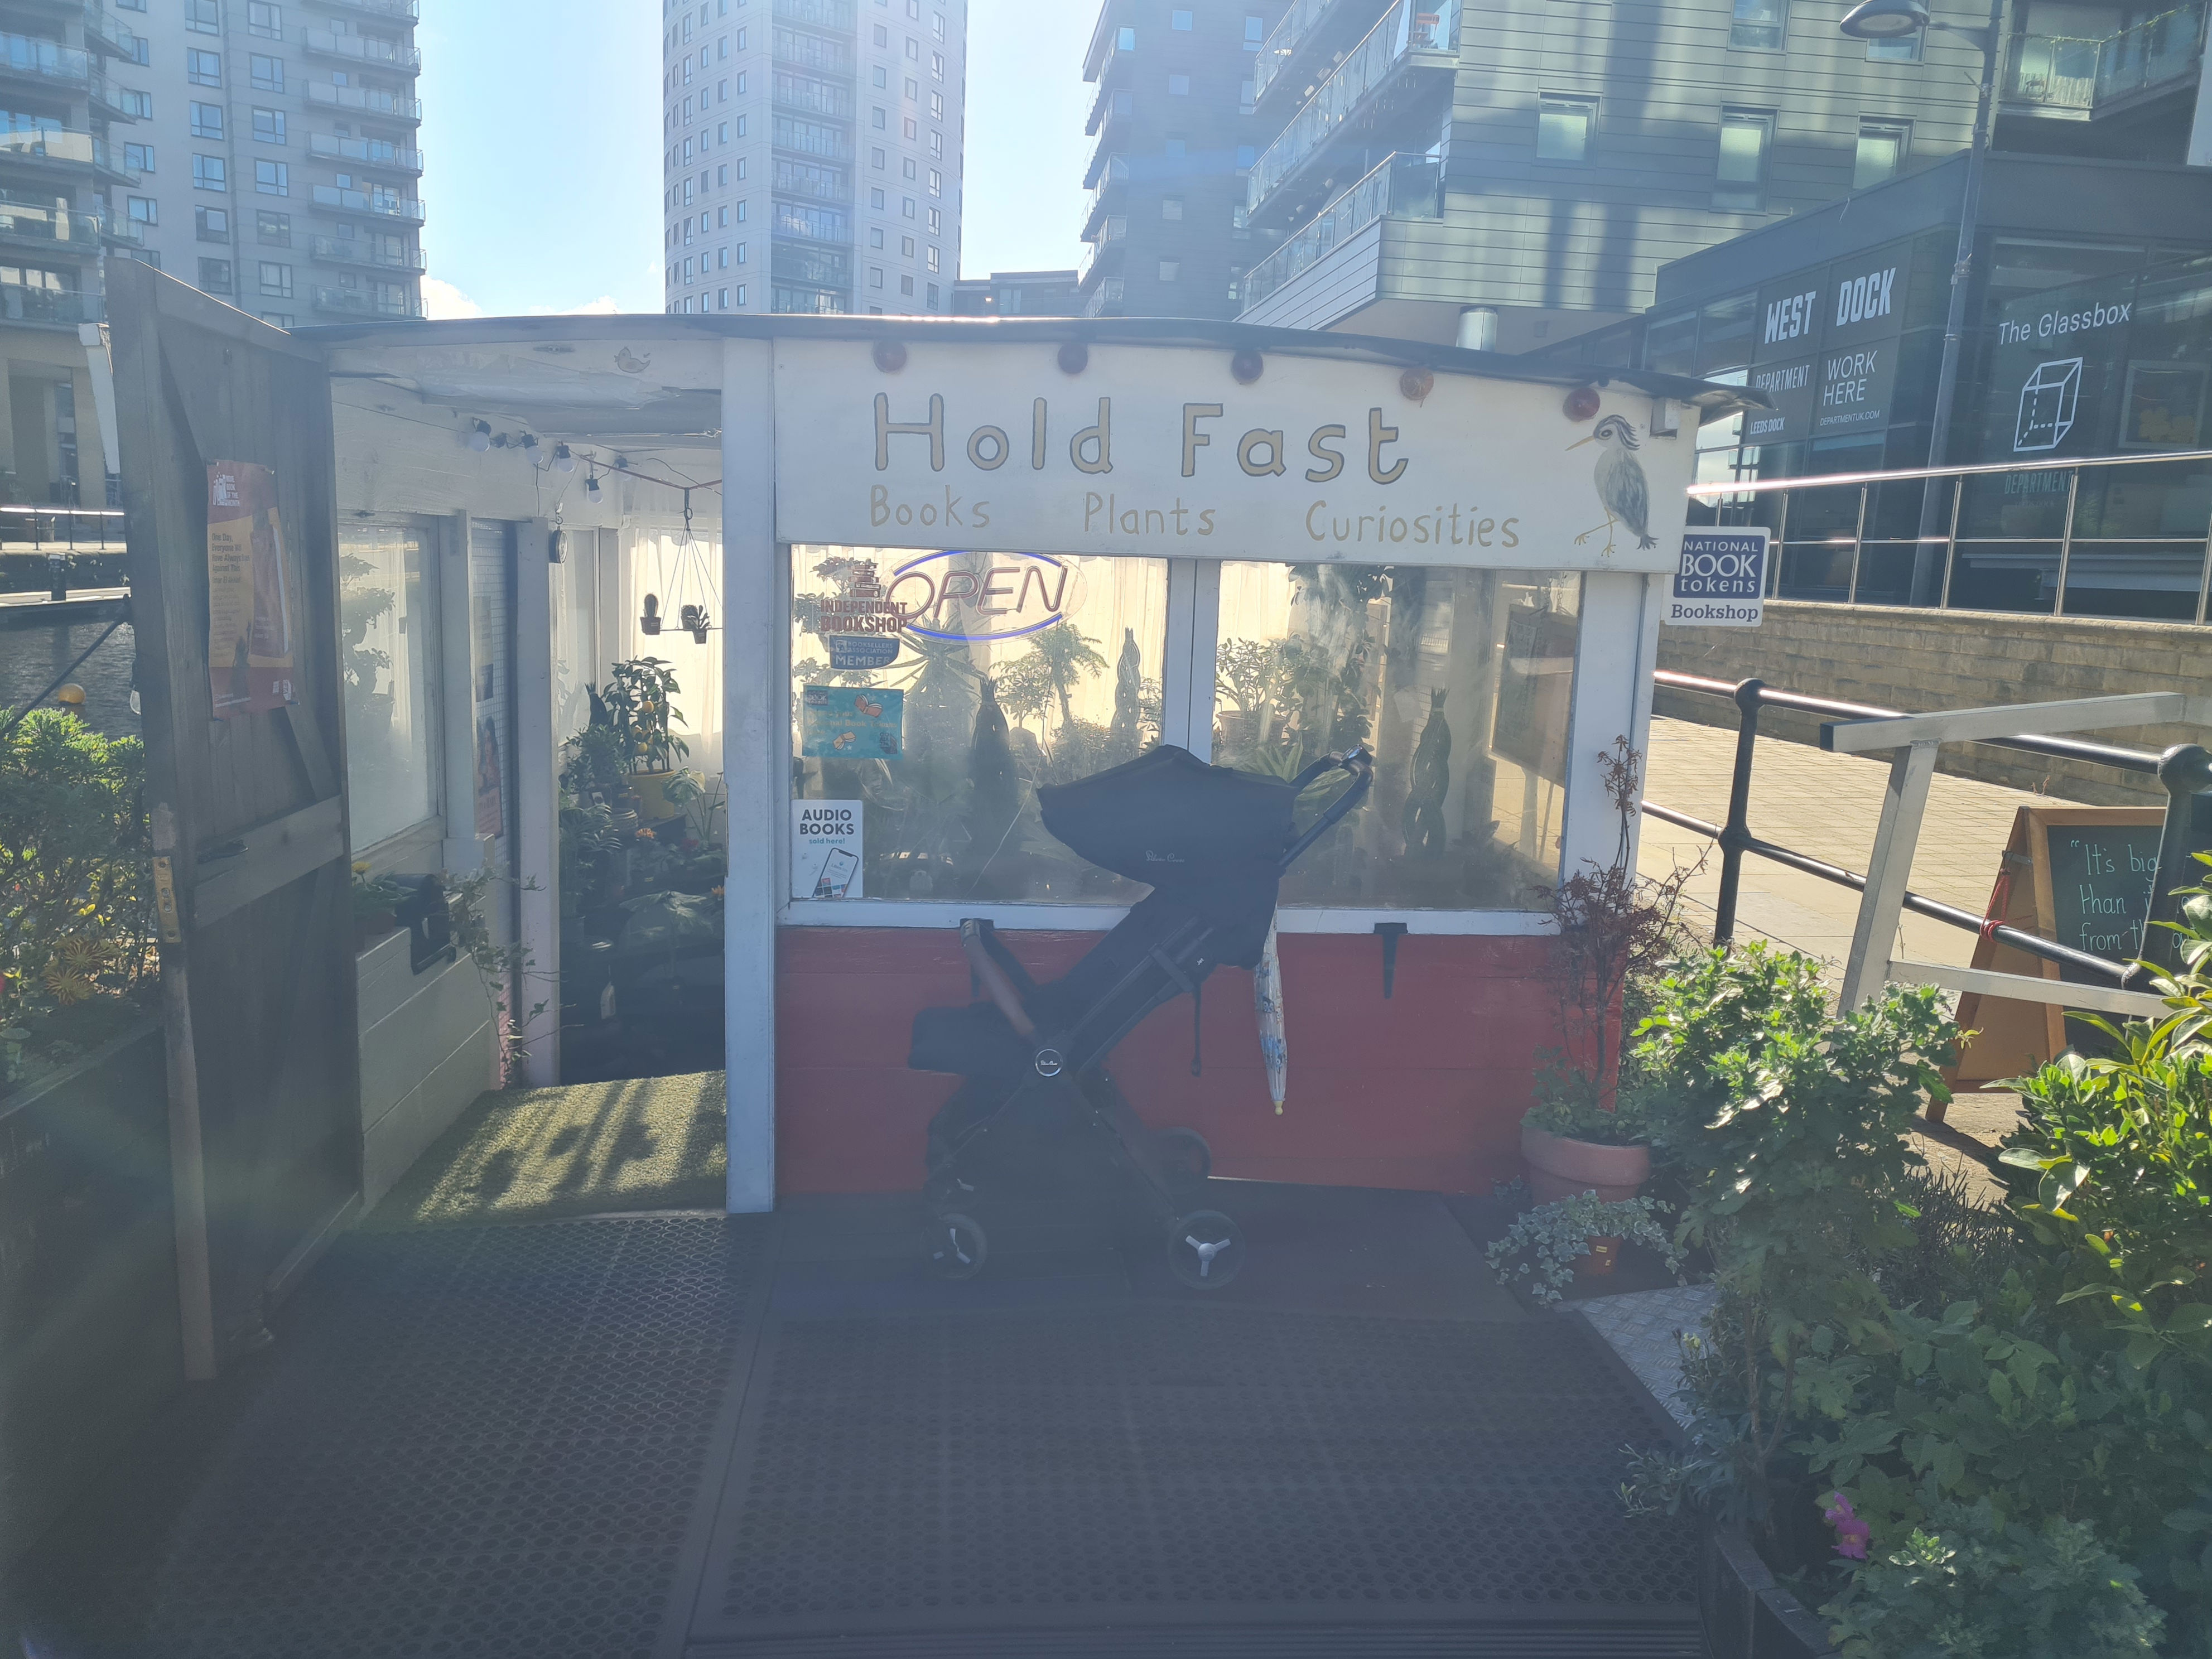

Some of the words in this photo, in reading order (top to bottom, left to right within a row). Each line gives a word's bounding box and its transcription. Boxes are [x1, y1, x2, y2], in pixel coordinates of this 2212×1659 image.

[1765, 291, 1816, 344] WEST
[1836, 267, 1896, 326] DOCK
[1999, 320, 2031, 345] The
[2038, 302, 2132, 337] Glassbox
[1828, 350, 1878, 380] WORK
[1756, 365, 1810, 392] DEPARTMENT
[1823, 378, 1867, 406] HERE
[1750, 419, 1768, 435] LEEDS
[1768, 417, 1785, 432] DOCK
[1820, 410, 1880, 426] DEPARTMENTUK.COM
[874, 392, 1114, 474] Hold
[1180, 402, 1409, 485] Fast
[2004, 470, 2074, 494] DEPARTMENT
[870, 484, 990, 528] Books
[1084, 491, 1216, 536] Plants
[1305, 500, 1520, 548] Curiosities
[212, 533, 221, 541] One
[1684, 541, 1758, 552] NATIONAL
[1681, 553, 1757, 577] BOOK
[885, 566, 1068, 619] OPEN
[1681, 577, 1755, 592] tokens
[821, 600, 908, 614] INDEPENDENT
[1671, 604, 1758, 622] Bookshop
[821, 616, 907, 633] BOOKSHOP
[836, 655, 890, 666] MEMBER
[802, 809, 852, 821] AUDIO
[799, 823, 854, 835] BOOKS
[2079, 884, 2127, 914] than
[2079, 922, 2122, 950] from
